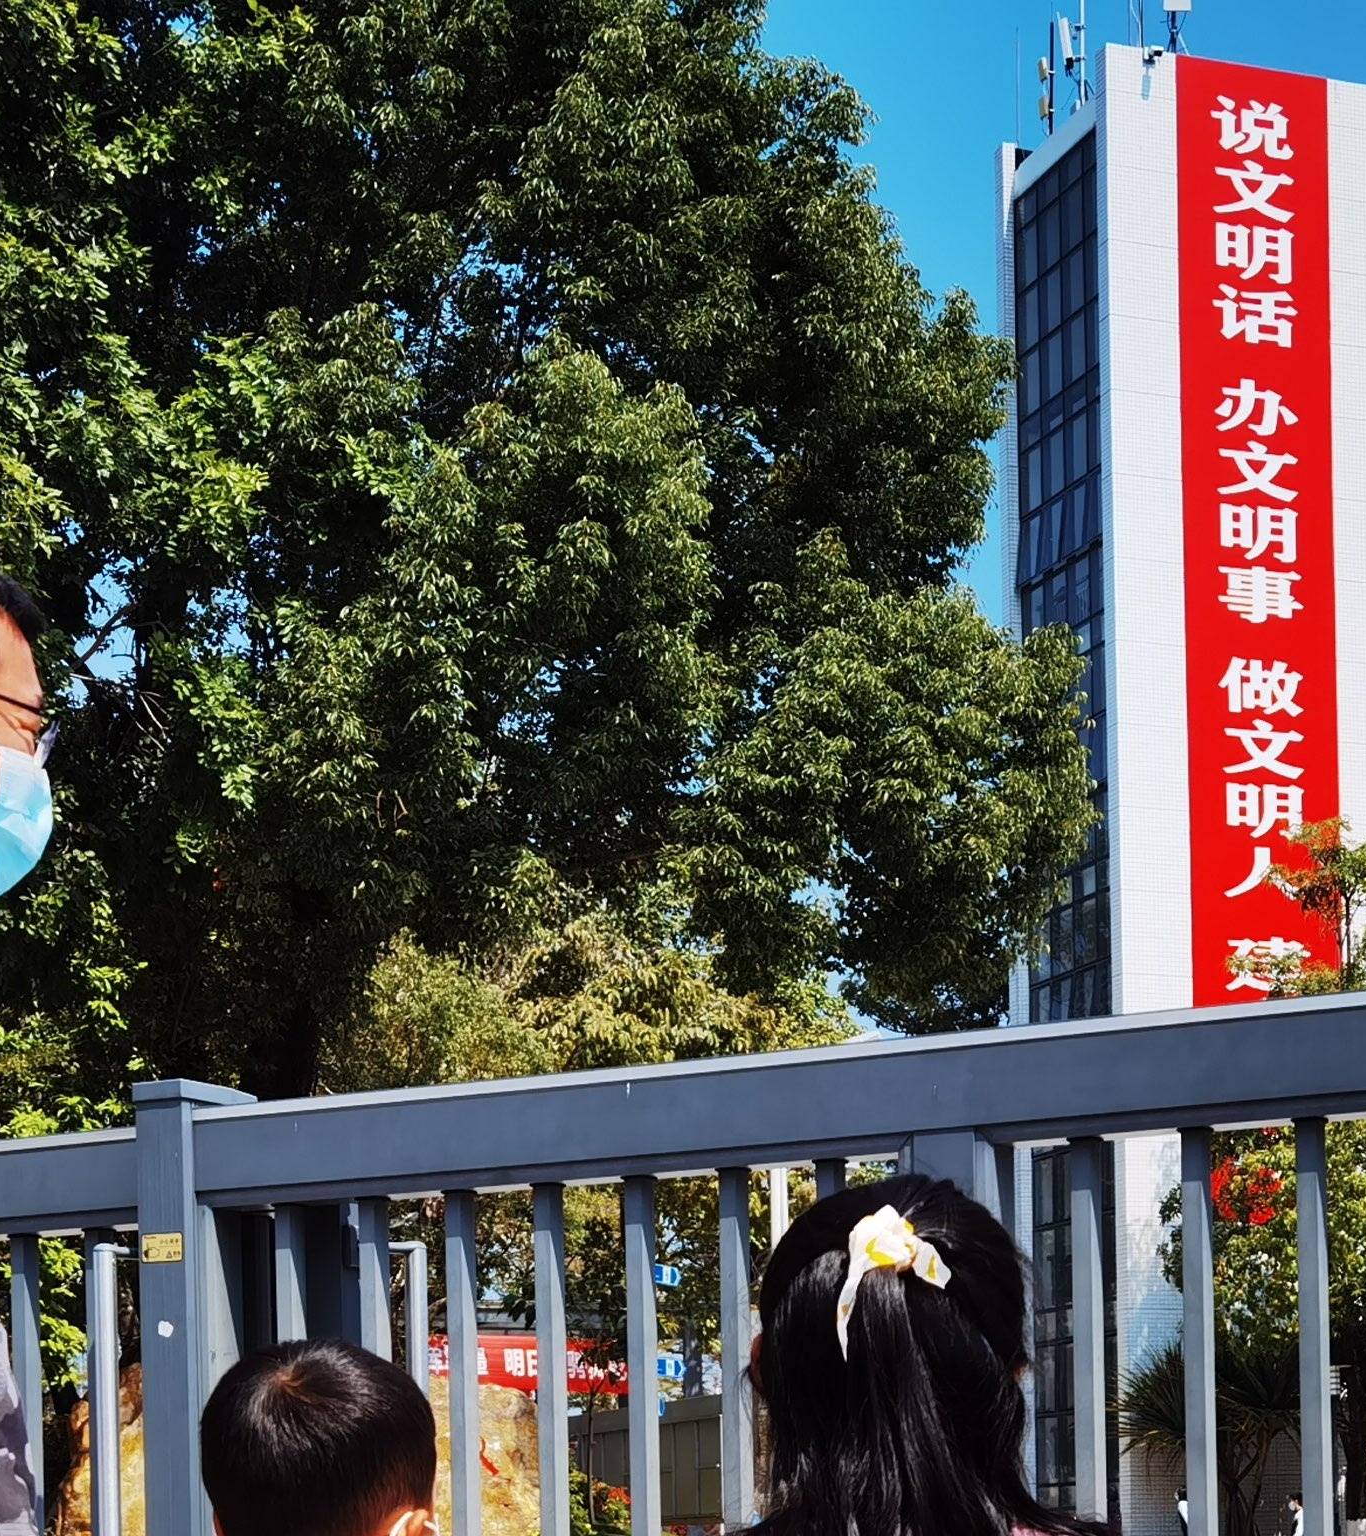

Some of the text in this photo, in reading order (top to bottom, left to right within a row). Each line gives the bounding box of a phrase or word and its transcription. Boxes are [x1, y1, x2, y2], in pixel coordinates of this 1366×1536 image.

[1210, 94, 1298, 350] 说文明话
[1213, 377, 1304, 623] 办文明事
[1218, 655, 1304, 899] 做文明人
